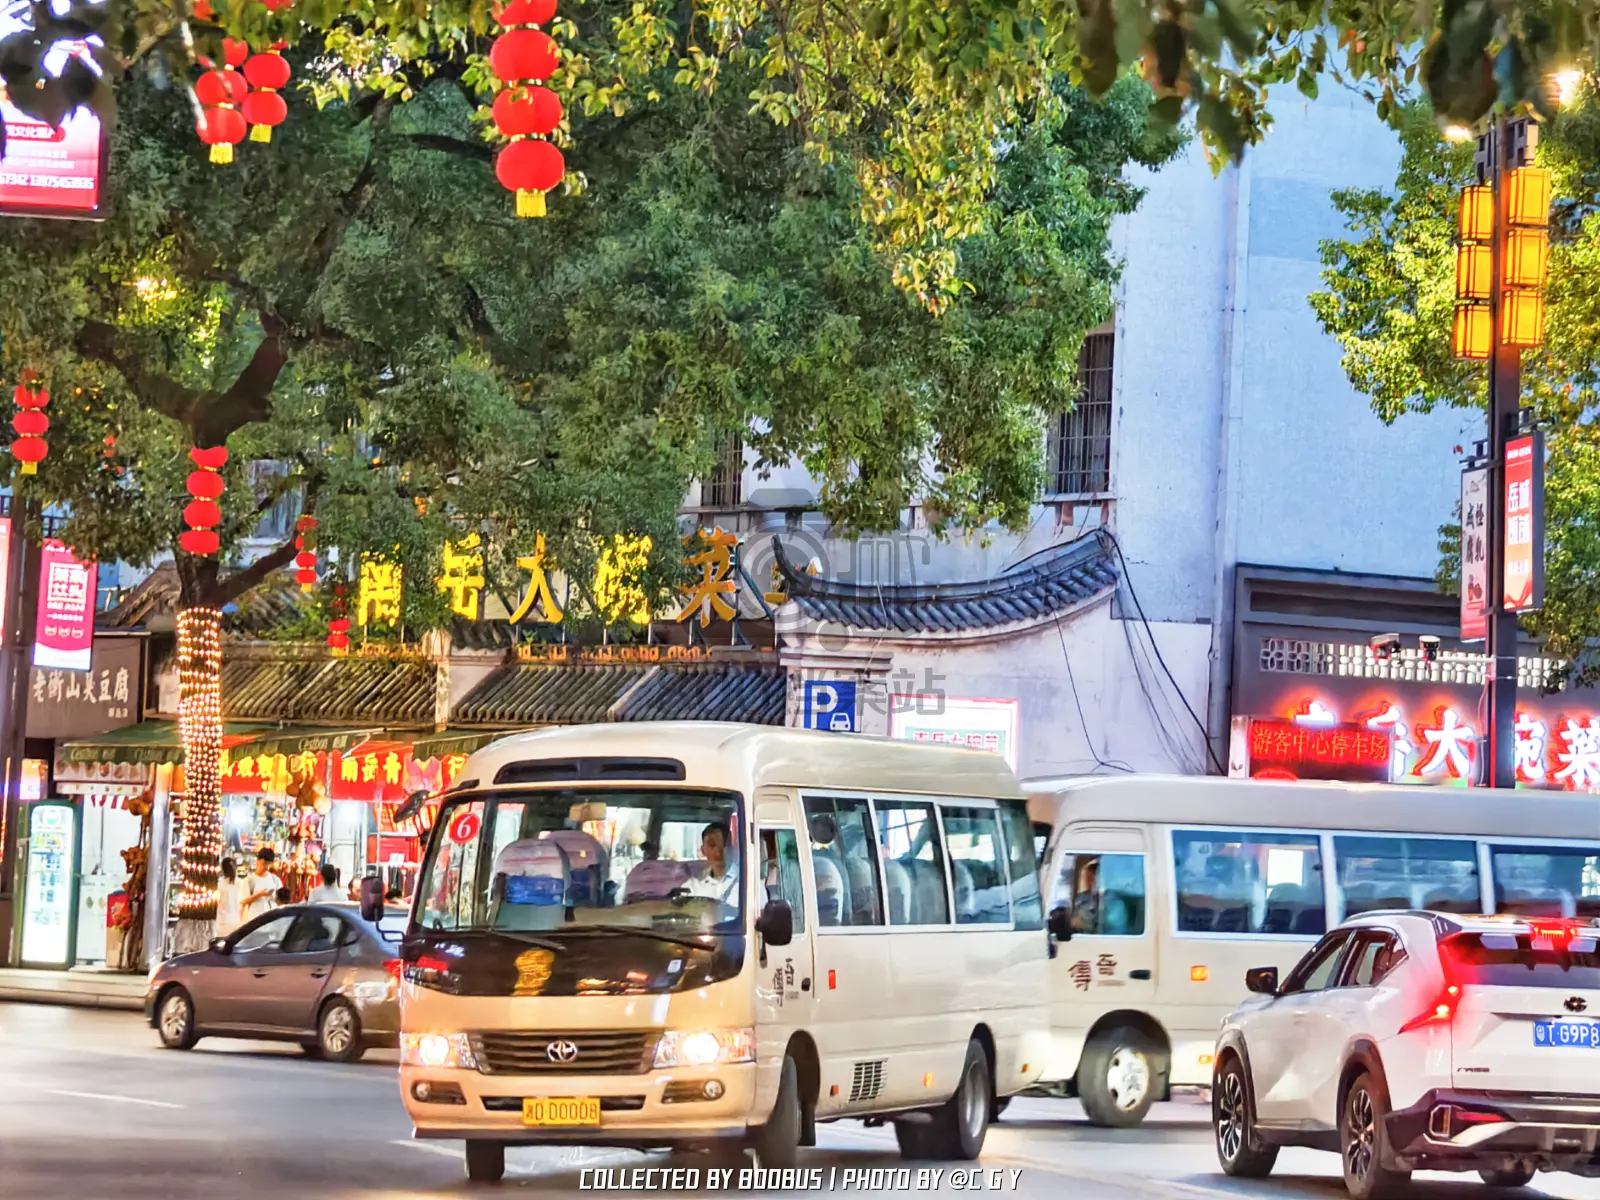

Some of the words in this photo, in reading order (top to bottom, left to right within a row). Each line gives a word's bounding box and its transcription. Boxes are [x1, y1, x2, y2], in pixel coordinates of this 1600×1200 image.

[1252, 728, 1387, 761] 游客中心停车场
[456, 819, 472, 839] 6
